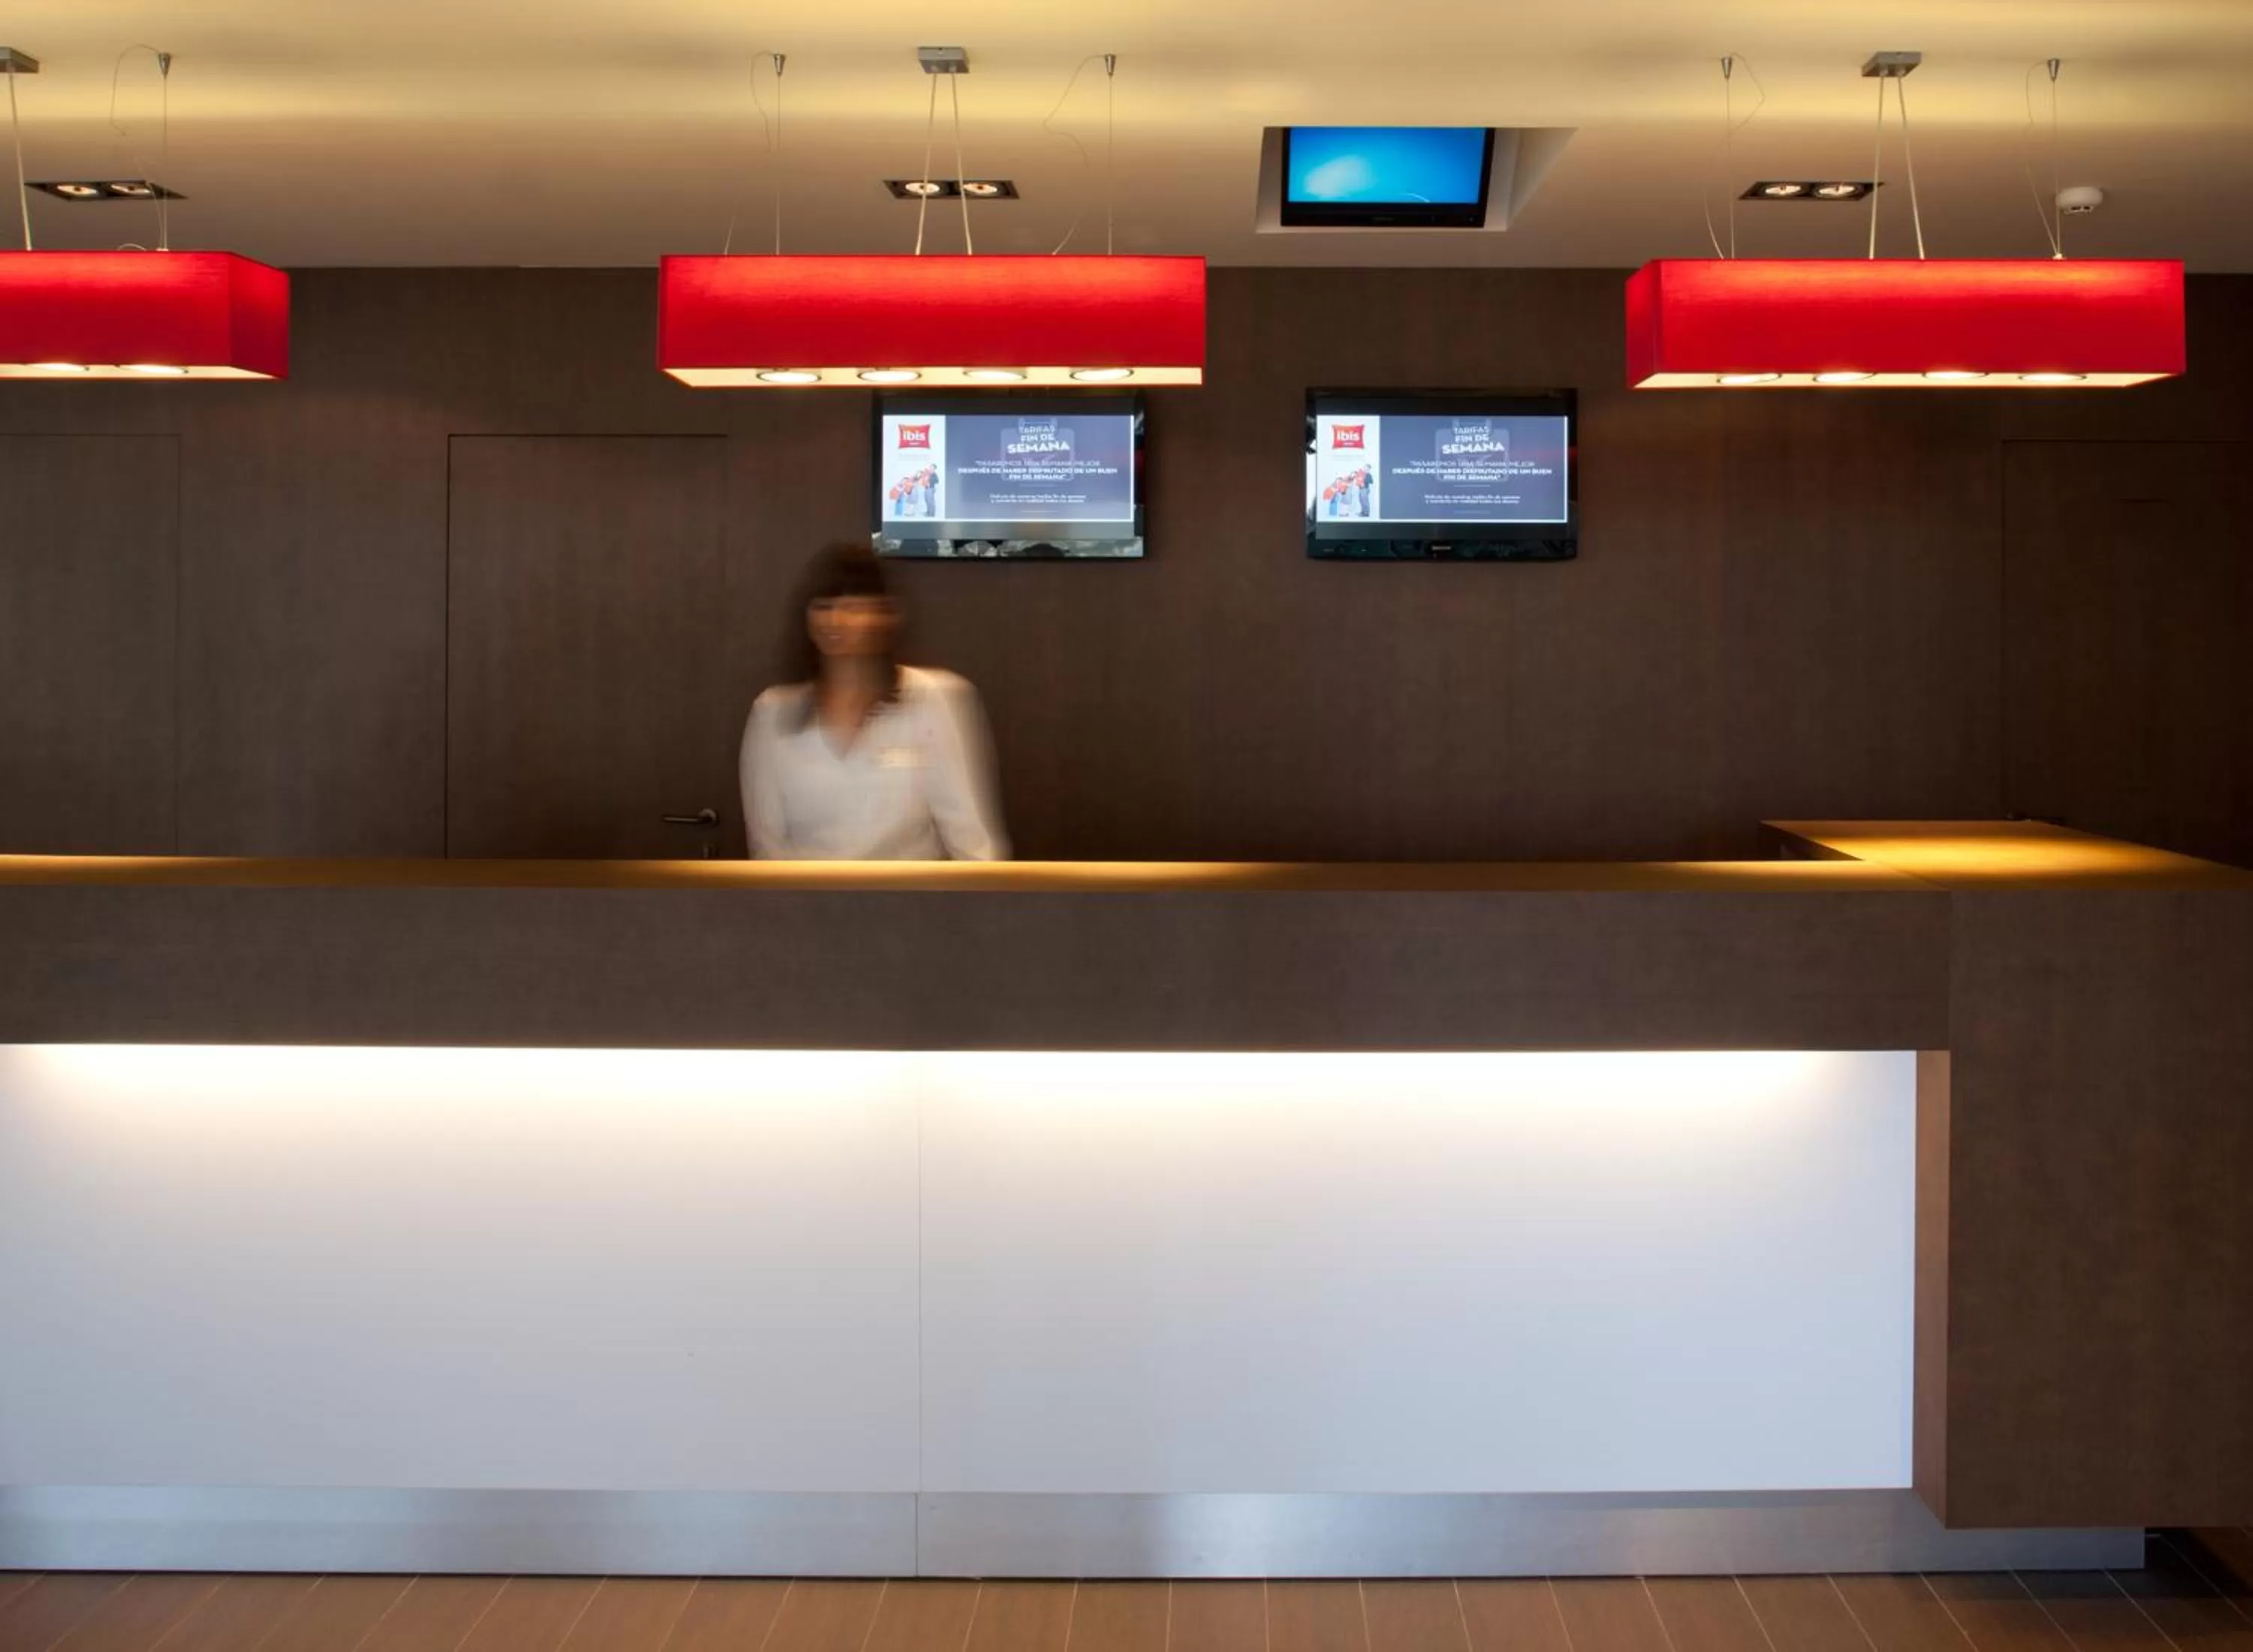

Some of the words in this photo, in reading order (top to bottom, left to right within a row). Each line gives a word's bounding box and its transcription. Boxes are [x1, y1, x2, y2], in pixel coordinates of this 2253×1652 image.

[903, 430, 926, 441] ibis
[1337, 430, 1360, 441] ibis
[1474, 433, 1489, 442] DE
[1007, 442, 1070, 454] SEMANA
[1441, 442, 1505, 454] SEMANA
